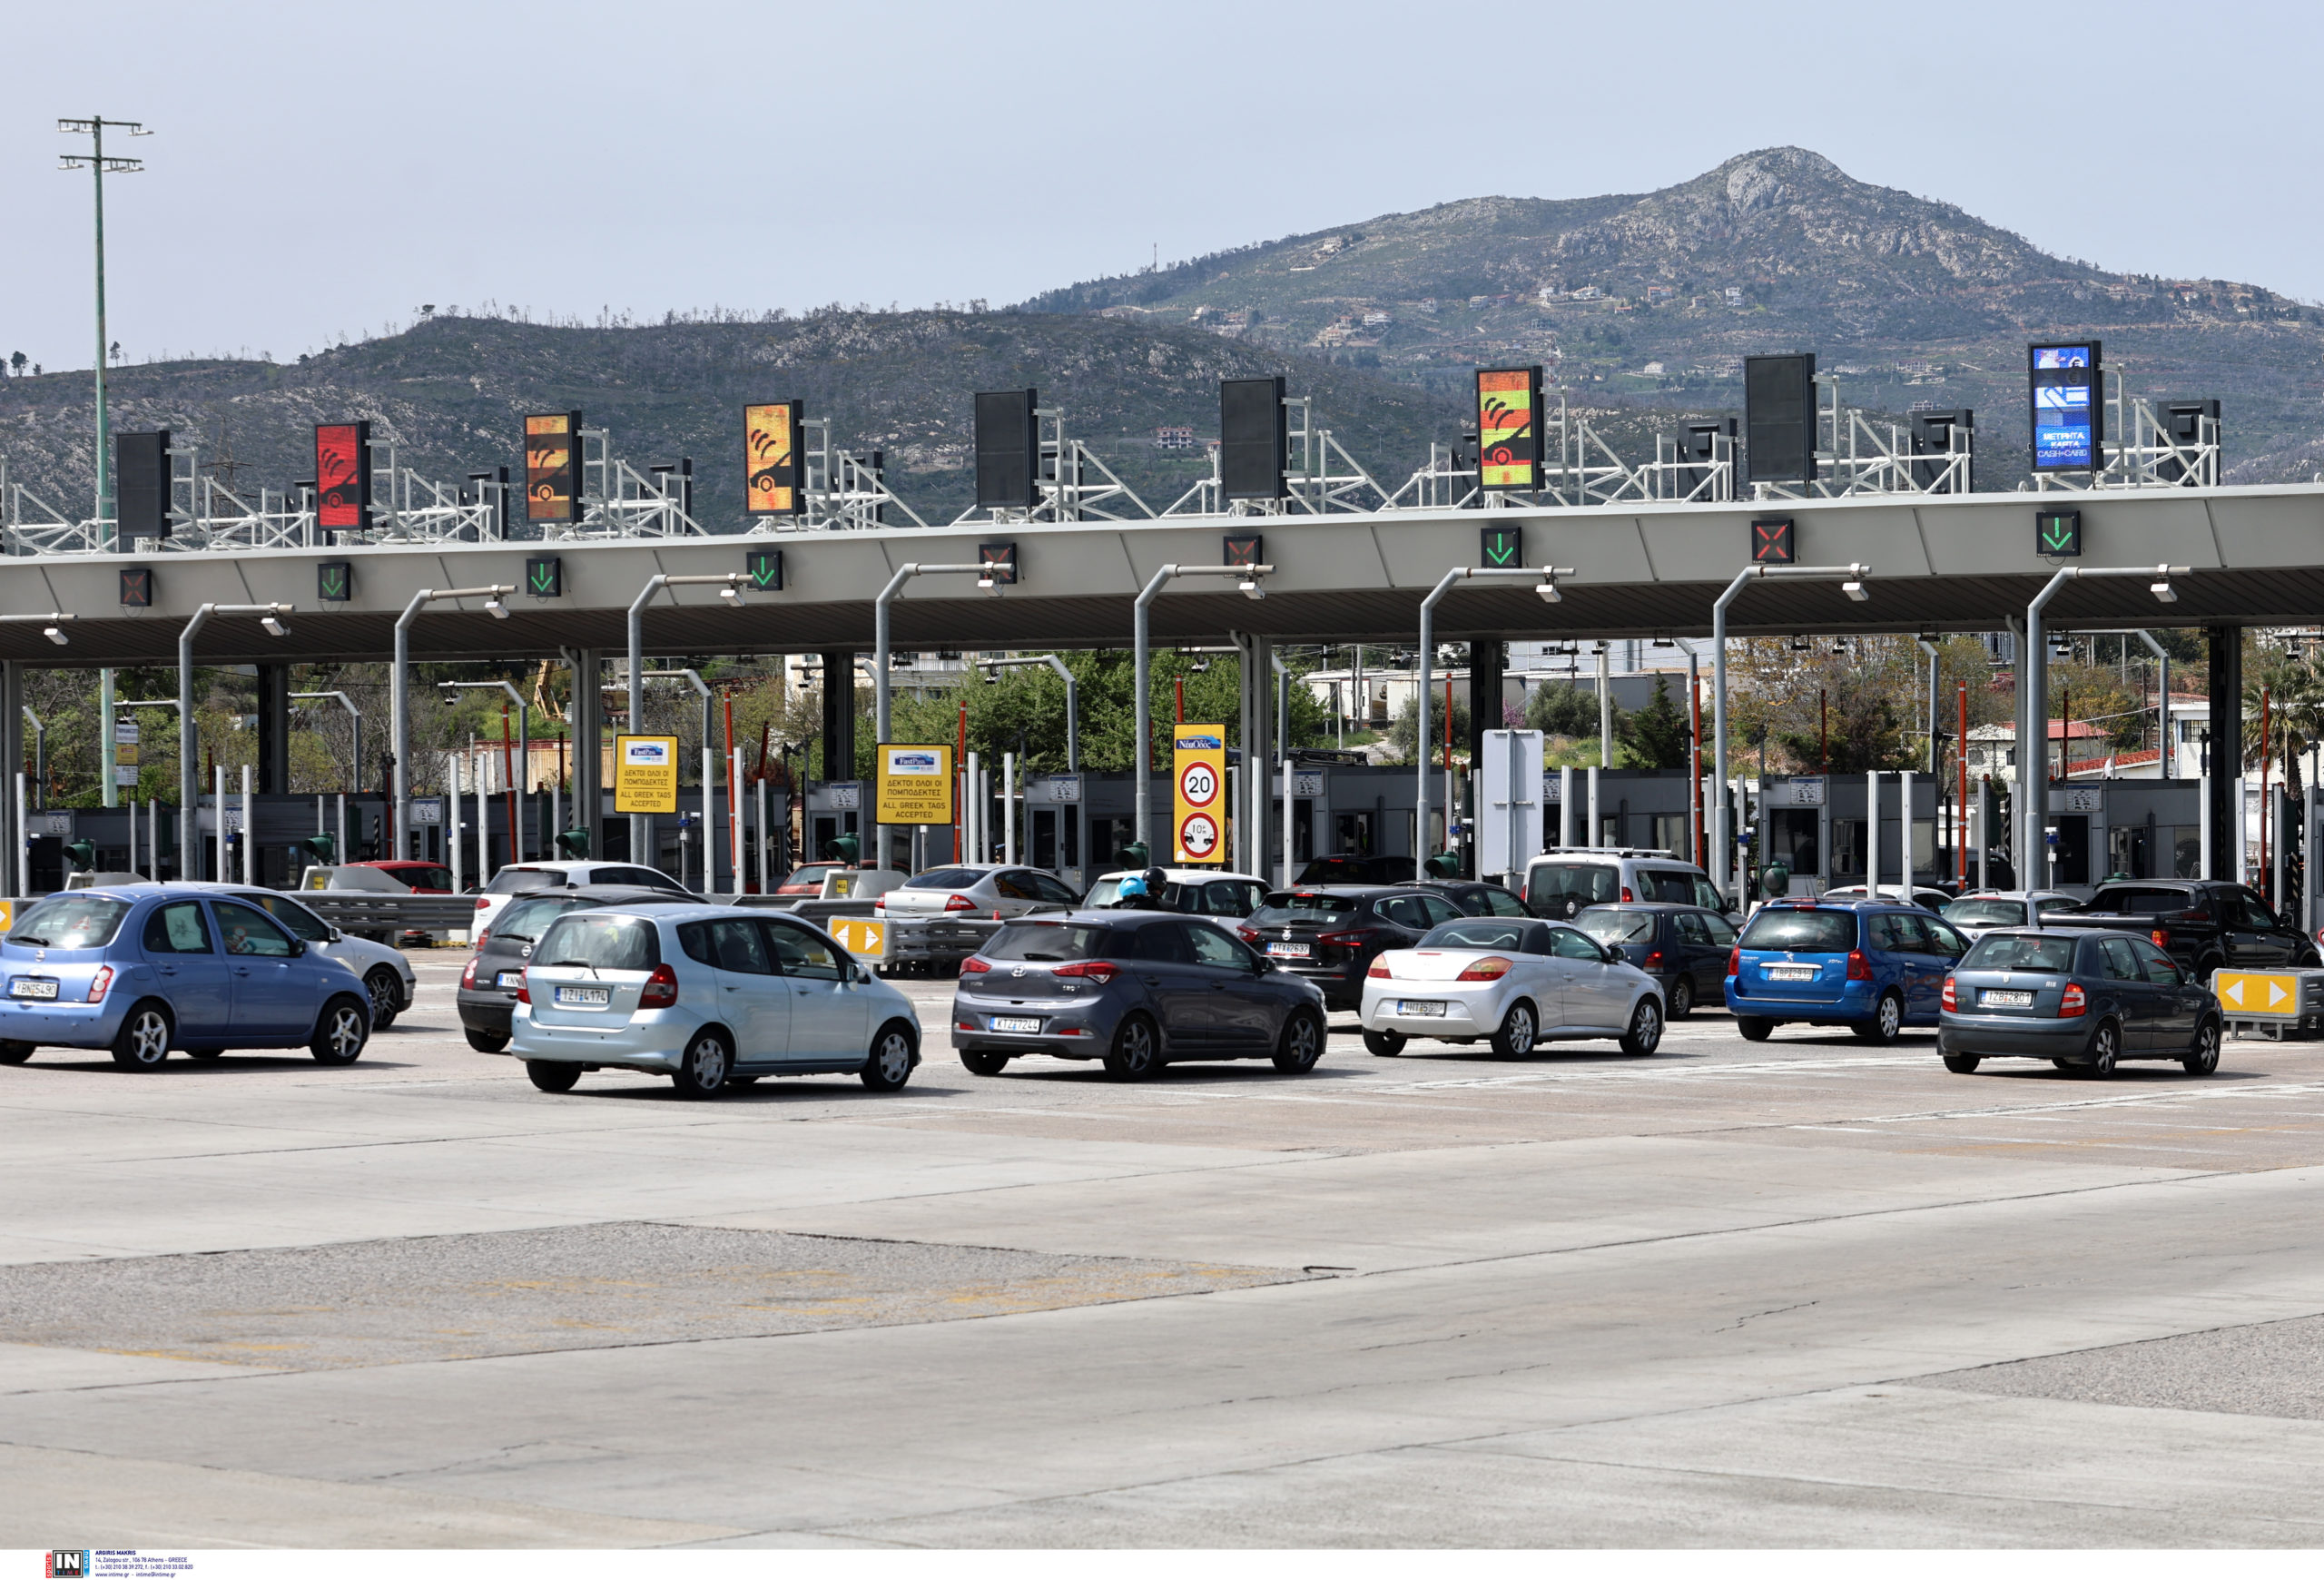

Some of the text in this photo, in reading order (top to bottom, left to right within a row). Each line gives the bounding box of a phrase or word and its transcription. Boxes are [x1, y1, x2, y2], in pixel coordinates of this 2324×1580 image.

[624, 778, 668, 786] ΠΟΜΠΟΔΕΚΤΕΣ
[887, 779, 913, 787] ΔΕΚΤΟΙ
[1188, 776, 1210, 794] 20
